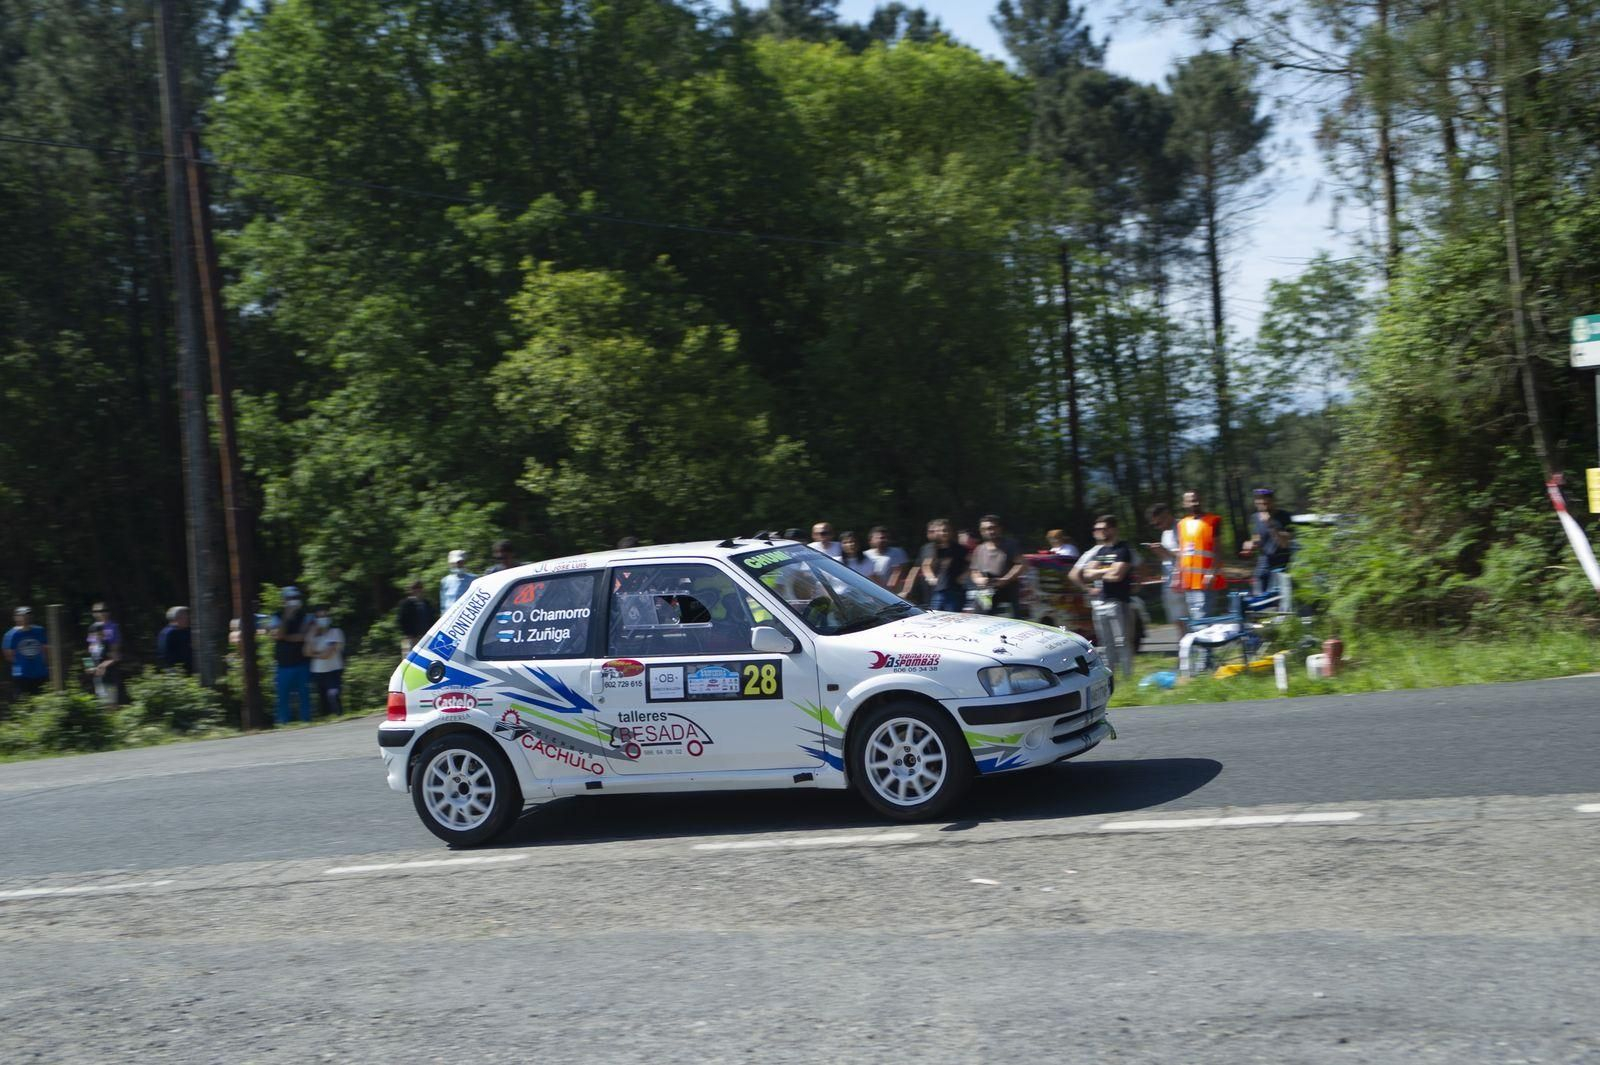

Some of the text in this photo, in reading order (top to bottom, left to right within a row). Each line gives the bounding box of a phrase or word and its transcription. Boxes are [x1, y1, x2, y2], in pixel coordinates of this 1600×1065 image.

[448, 588, 491, 639] PONTEAREAS
[512, 608, 591, 623] O. Chamorro
[513, 627, 571, 643] J. Zuñiga
[659, 673, 674, 683] OB
[743, 664, 777, 696] 28
[434, 694, 475, 709] Castelo
[618, 710, 667, 723] talleres
[619, 723, 699, 742] BESADA
[521, 734, 605, 775] CACHULO
